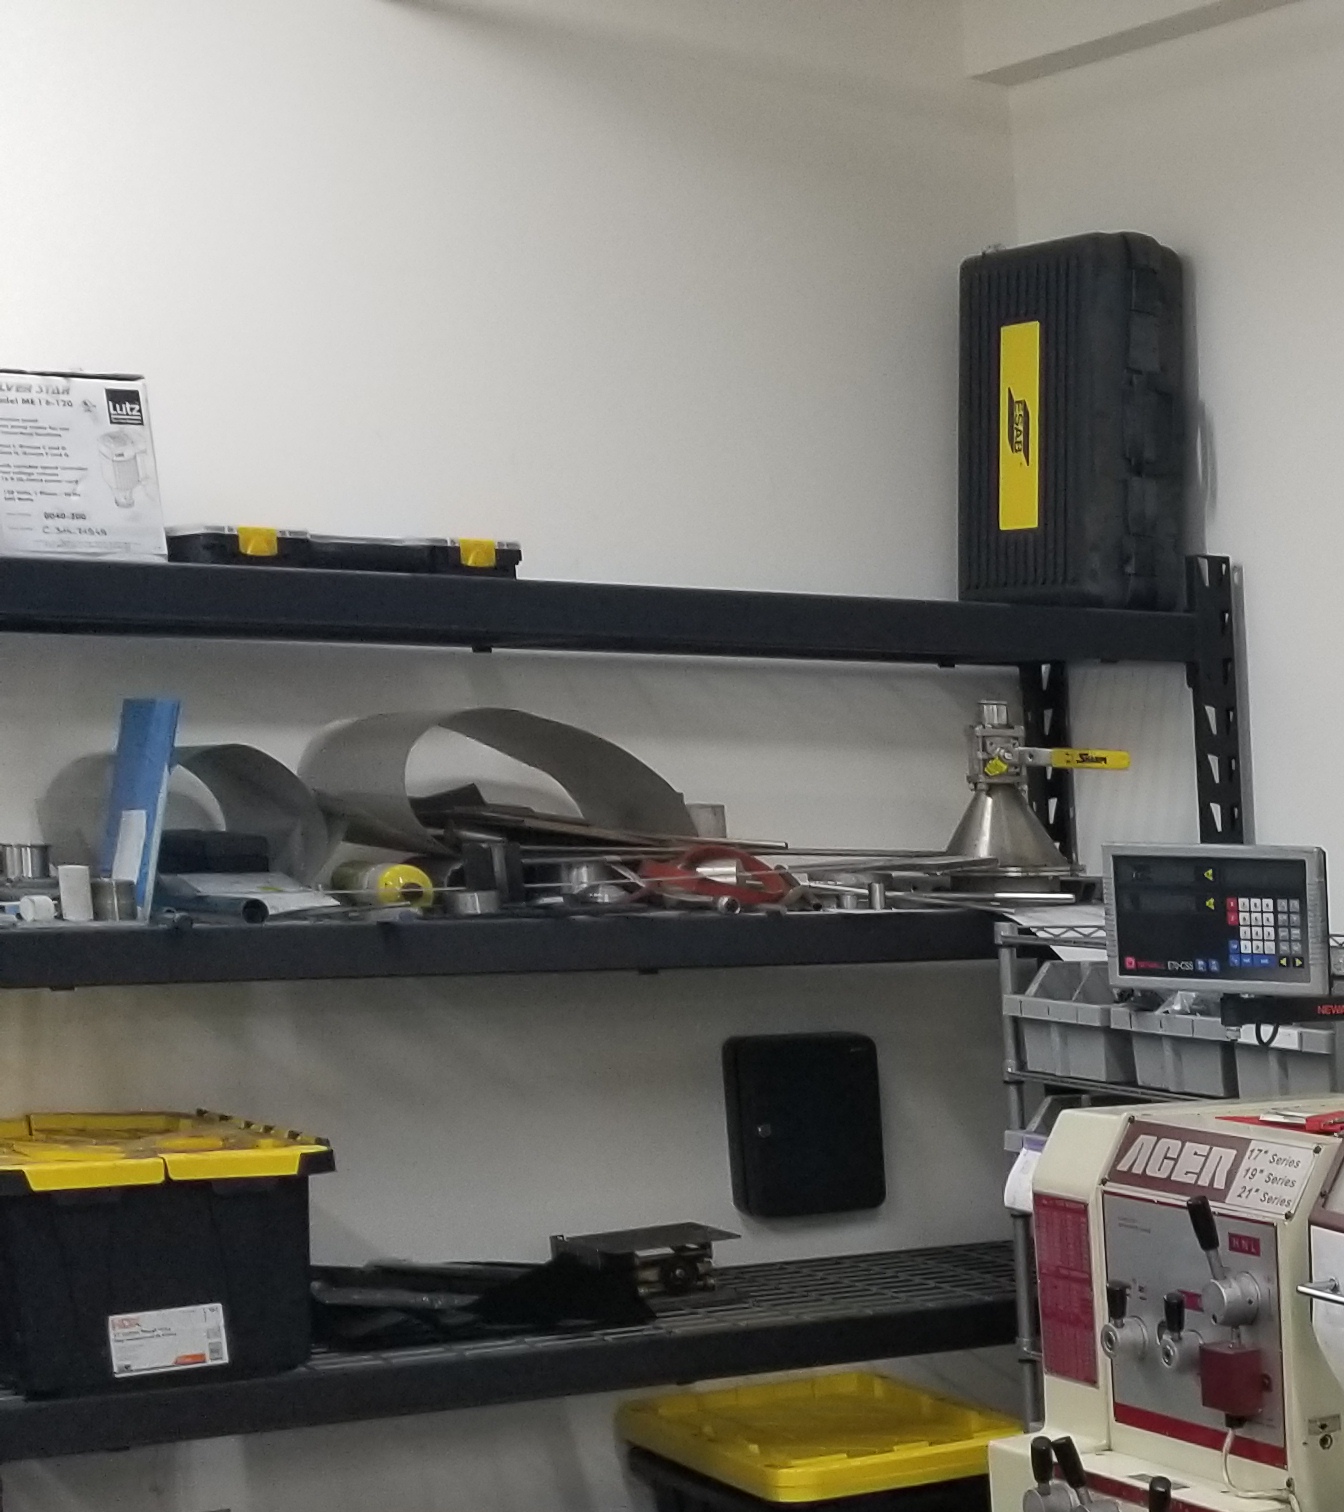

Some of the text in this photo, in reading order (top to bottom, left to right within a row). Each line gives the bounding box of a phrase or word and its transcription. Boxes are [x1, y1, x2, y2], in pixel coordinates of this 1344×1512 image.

[109, 400, 141, 416] Lutz
[1116, 1134, 1238, 1190] ACER
[1248, 1148, 1301, 1169] 17" Series
[1243, 1167, 1297, 1188] 19" Series
[1237, 1185, 1292, 1208] 21" Series
